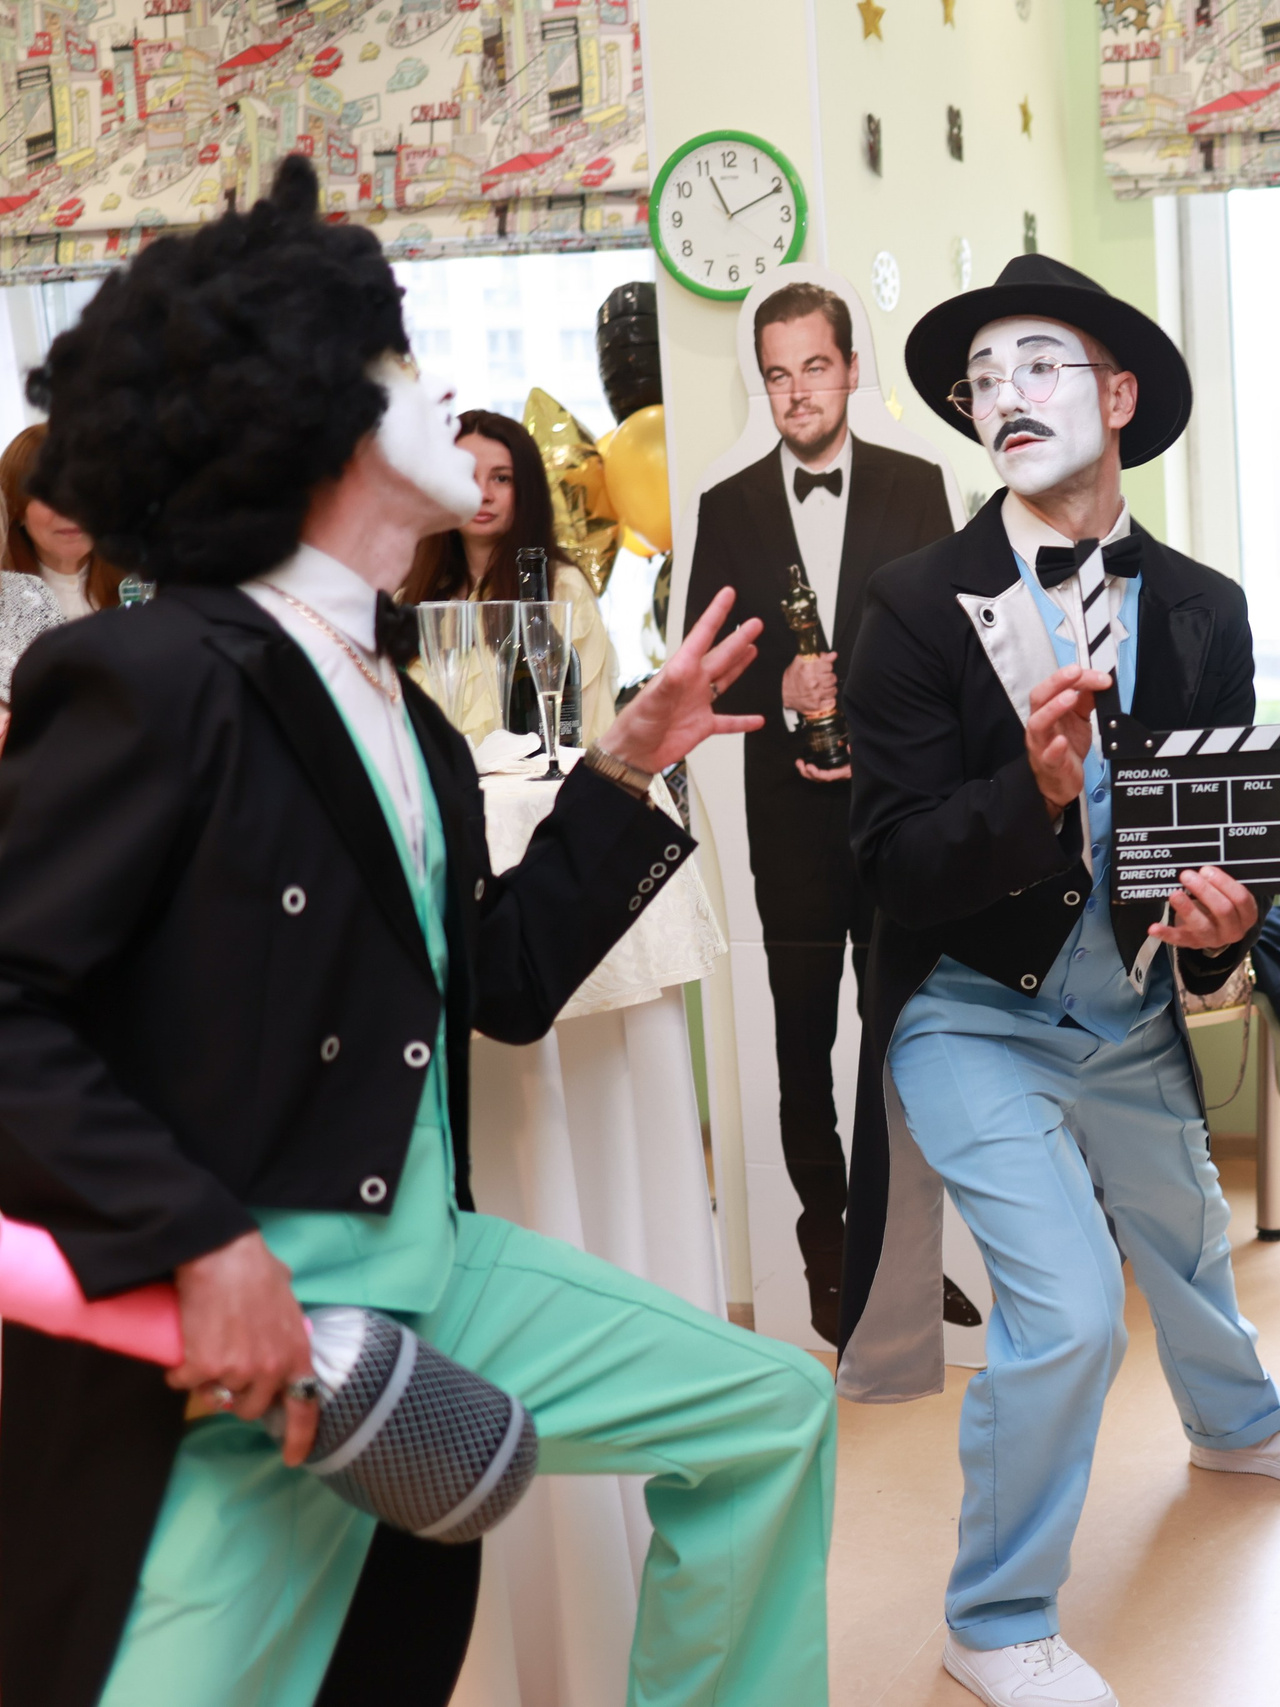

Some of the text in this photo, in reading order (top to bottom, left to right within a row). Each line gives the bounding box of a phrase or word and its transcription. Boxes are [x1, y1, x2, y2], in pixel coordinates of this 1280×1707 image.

[720, 151, 737, 168] 12
[753, 157, 759, 174] 1
[697, 160, 710, 177] 11
[676, 181, 693, 198] 10
[771, 176, 783, 193] 2
[672, 211, 683, 228] 9
[780, 205, 792, 223] 3
[682, 240, 693, 257] 8
[773, 235, 785, 252] 4
[704, 260, 714, 277] 7
[728, 265, 740, 282] 6
[755, 257, 766, 274] 5
[1117, 768, 1171, 780] PROD.NO.
[1126, 781, 1273, 797] SCENE TAKE ROLL
[1118, 832, 1149, 843] DATE
[1228, 826, 1268, 837] SOUND
[1119, 848, 1173, 860] PROD.CO.
[1119, 868, 1177, 881] DIRECTOR
